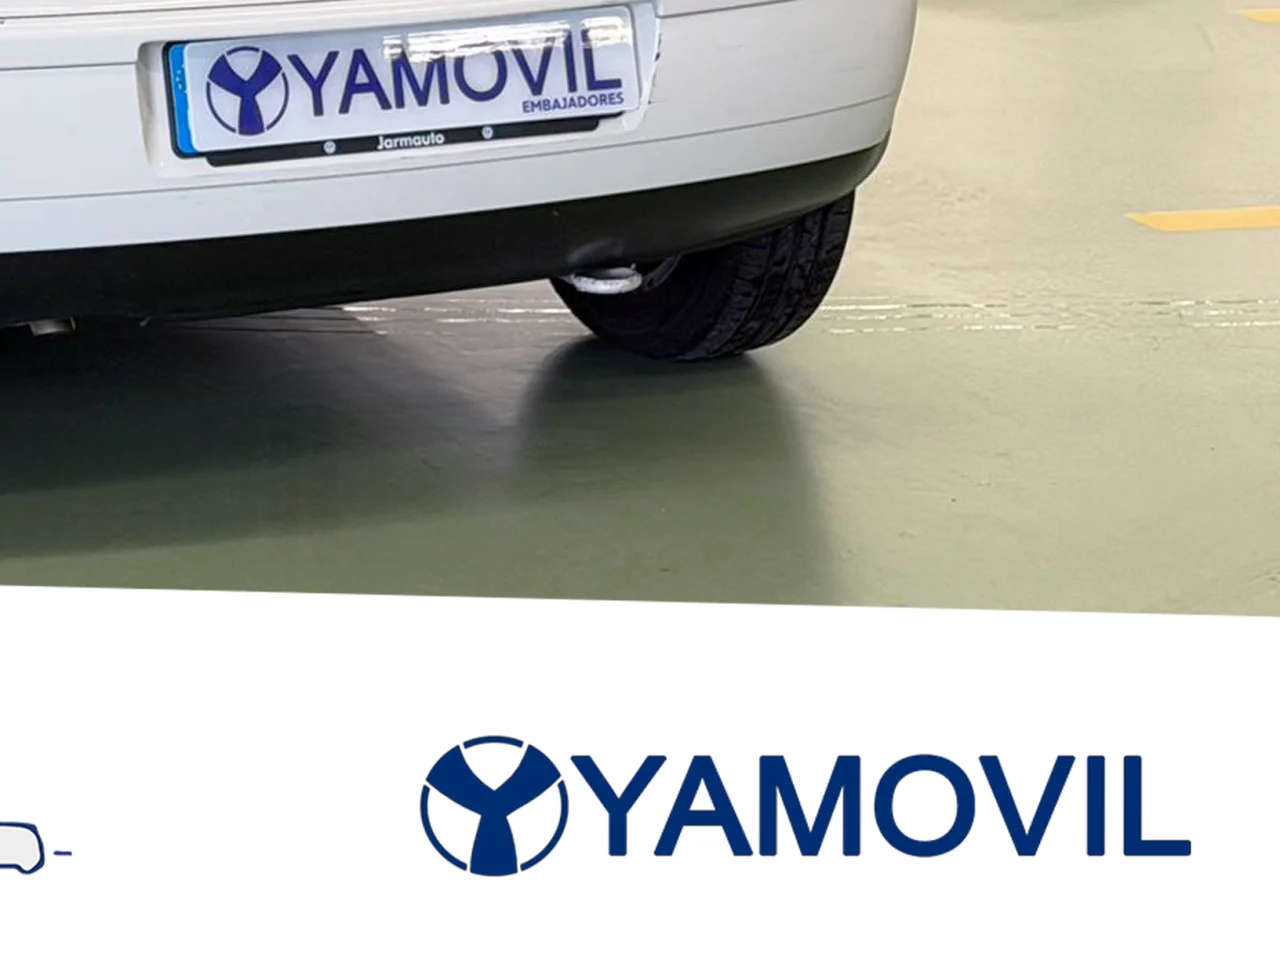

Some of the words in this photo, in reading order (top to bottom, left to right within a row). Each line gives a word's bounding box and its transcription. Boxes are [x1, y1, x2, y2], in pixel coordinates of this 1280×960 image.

[287, 27, 622, 117] YAMOVIL
[522, 92, 624, 113] EMBAJADORES
[376, 131, 445, 150] Jarmauto
